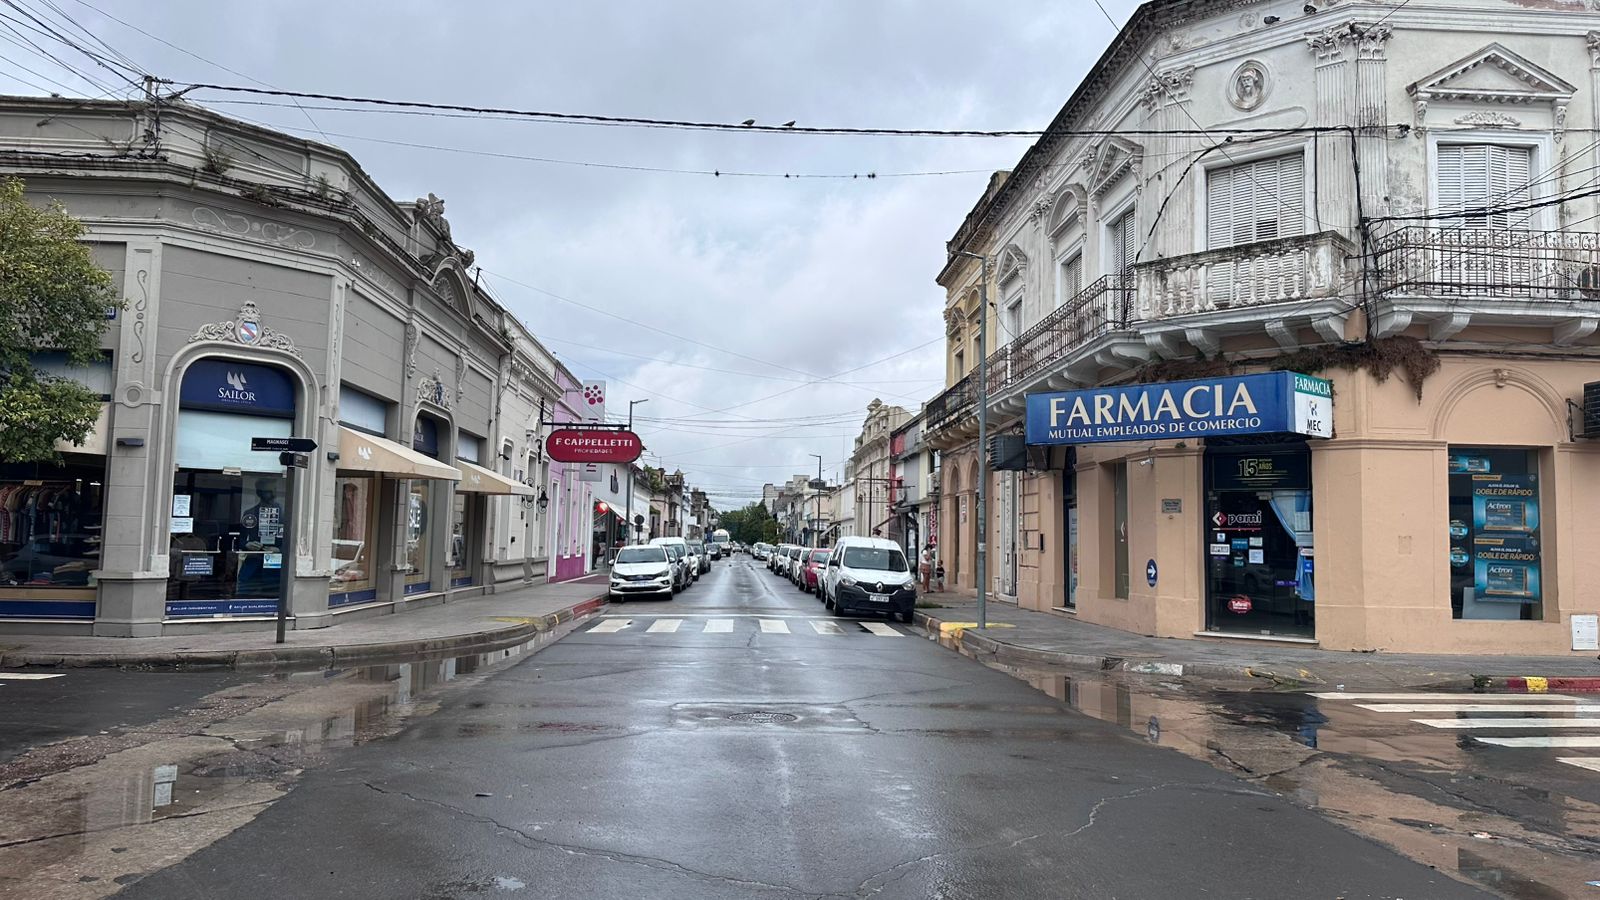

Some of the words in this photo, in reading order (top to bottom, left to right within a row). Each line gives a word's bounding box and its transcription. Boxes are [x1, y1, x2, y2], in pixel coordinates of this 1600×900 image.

[1295, 376, 1331, 396] FARMACIA
[218, 387, 256, 402] SAILOR
[1050, 382, 1258, 427] FARMACIA
[1048, 427, 1094, 439] MUTUAL
[1097, 422, 1166, 437] EMPLEADOS
[1169, 421, 1186, 433] DE
[1188, 416, 1261, 432] COMERCIO
[1306, 418, 1322, 432] MEC
[556, 438, 562, 446] F
[564, 438, 633, 446] CAPPELLETTI
[1238, 458, 1258, 476] 15
[1487, 502, 1512, 510] Actron
[1227, 510, 1262, 526] pami
